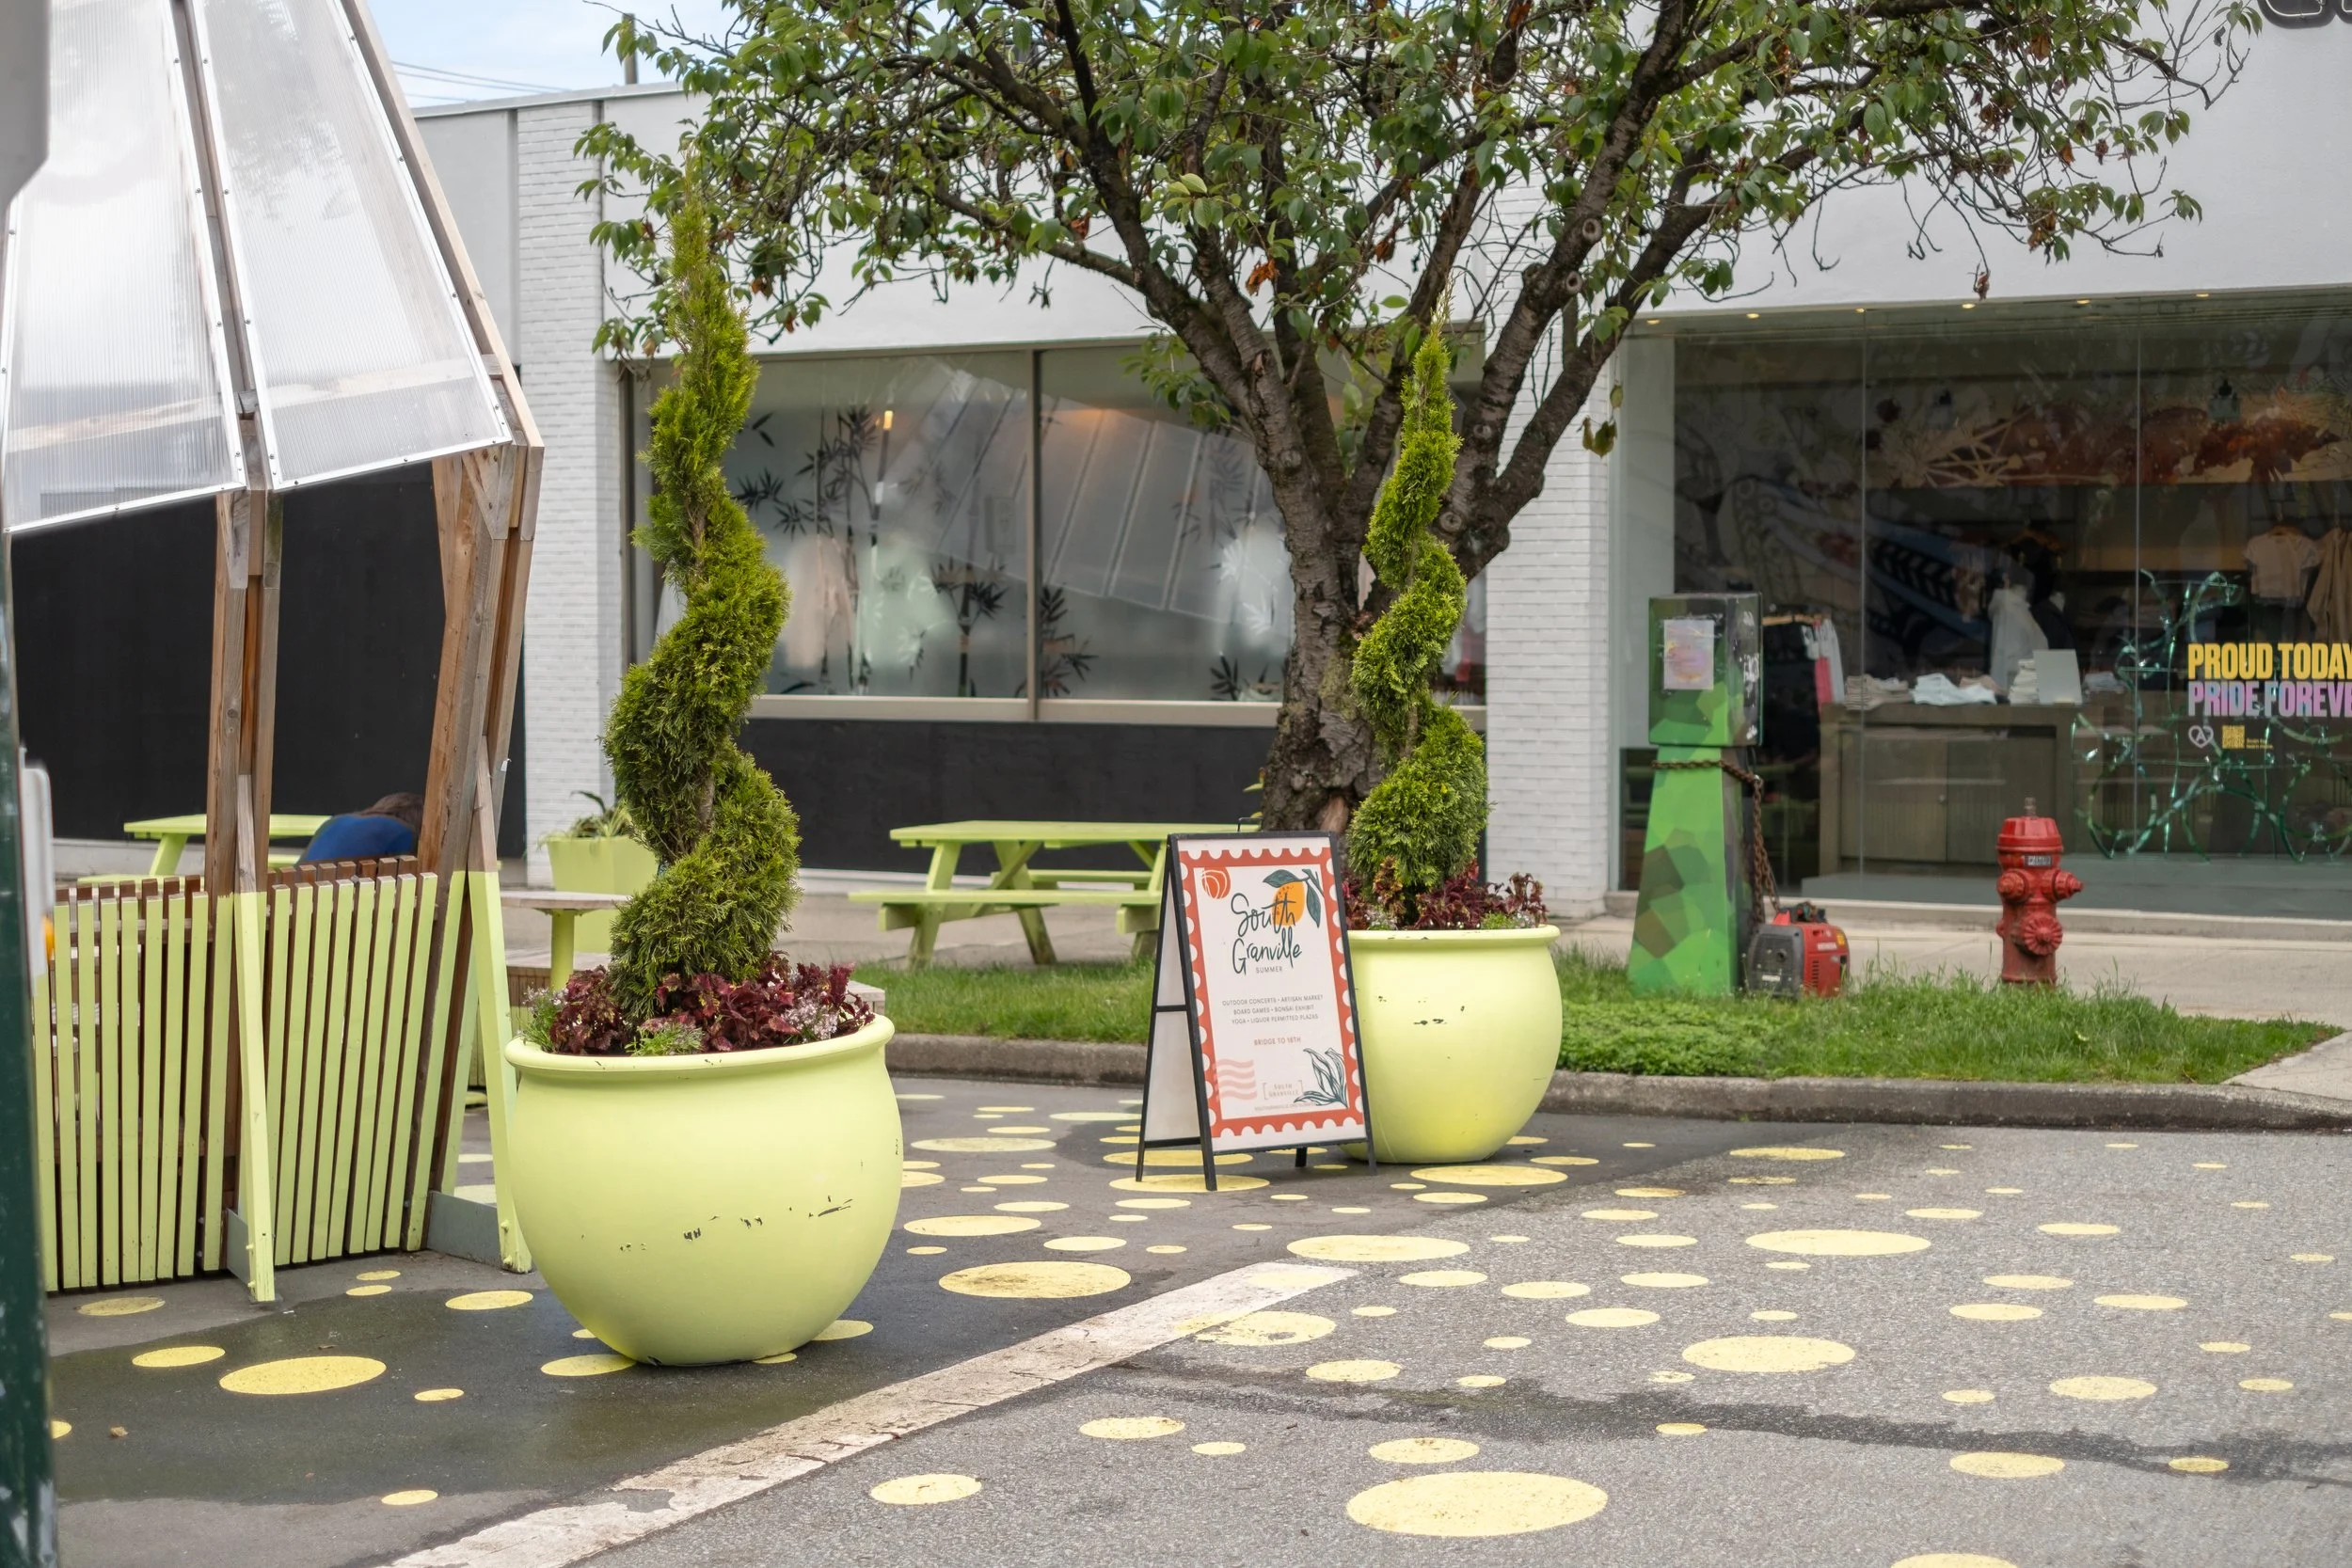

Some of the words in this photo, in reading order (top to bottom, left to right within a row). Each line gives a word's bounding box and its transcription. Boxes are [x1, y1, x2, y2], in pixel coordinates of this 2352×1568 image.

[2187, 642, 2273, 680] PROUD
[2278, 642, 2352, 680] TODAY
[2187, 680, 2260, 718] PRIDE
[1231, 892, 1296, 938] South
[1232, 926, 1303, 975] Granville
[1255, 965, 1283, 974] SUMMER
[1253, 1037, 1276, 1046] BRIDGE
